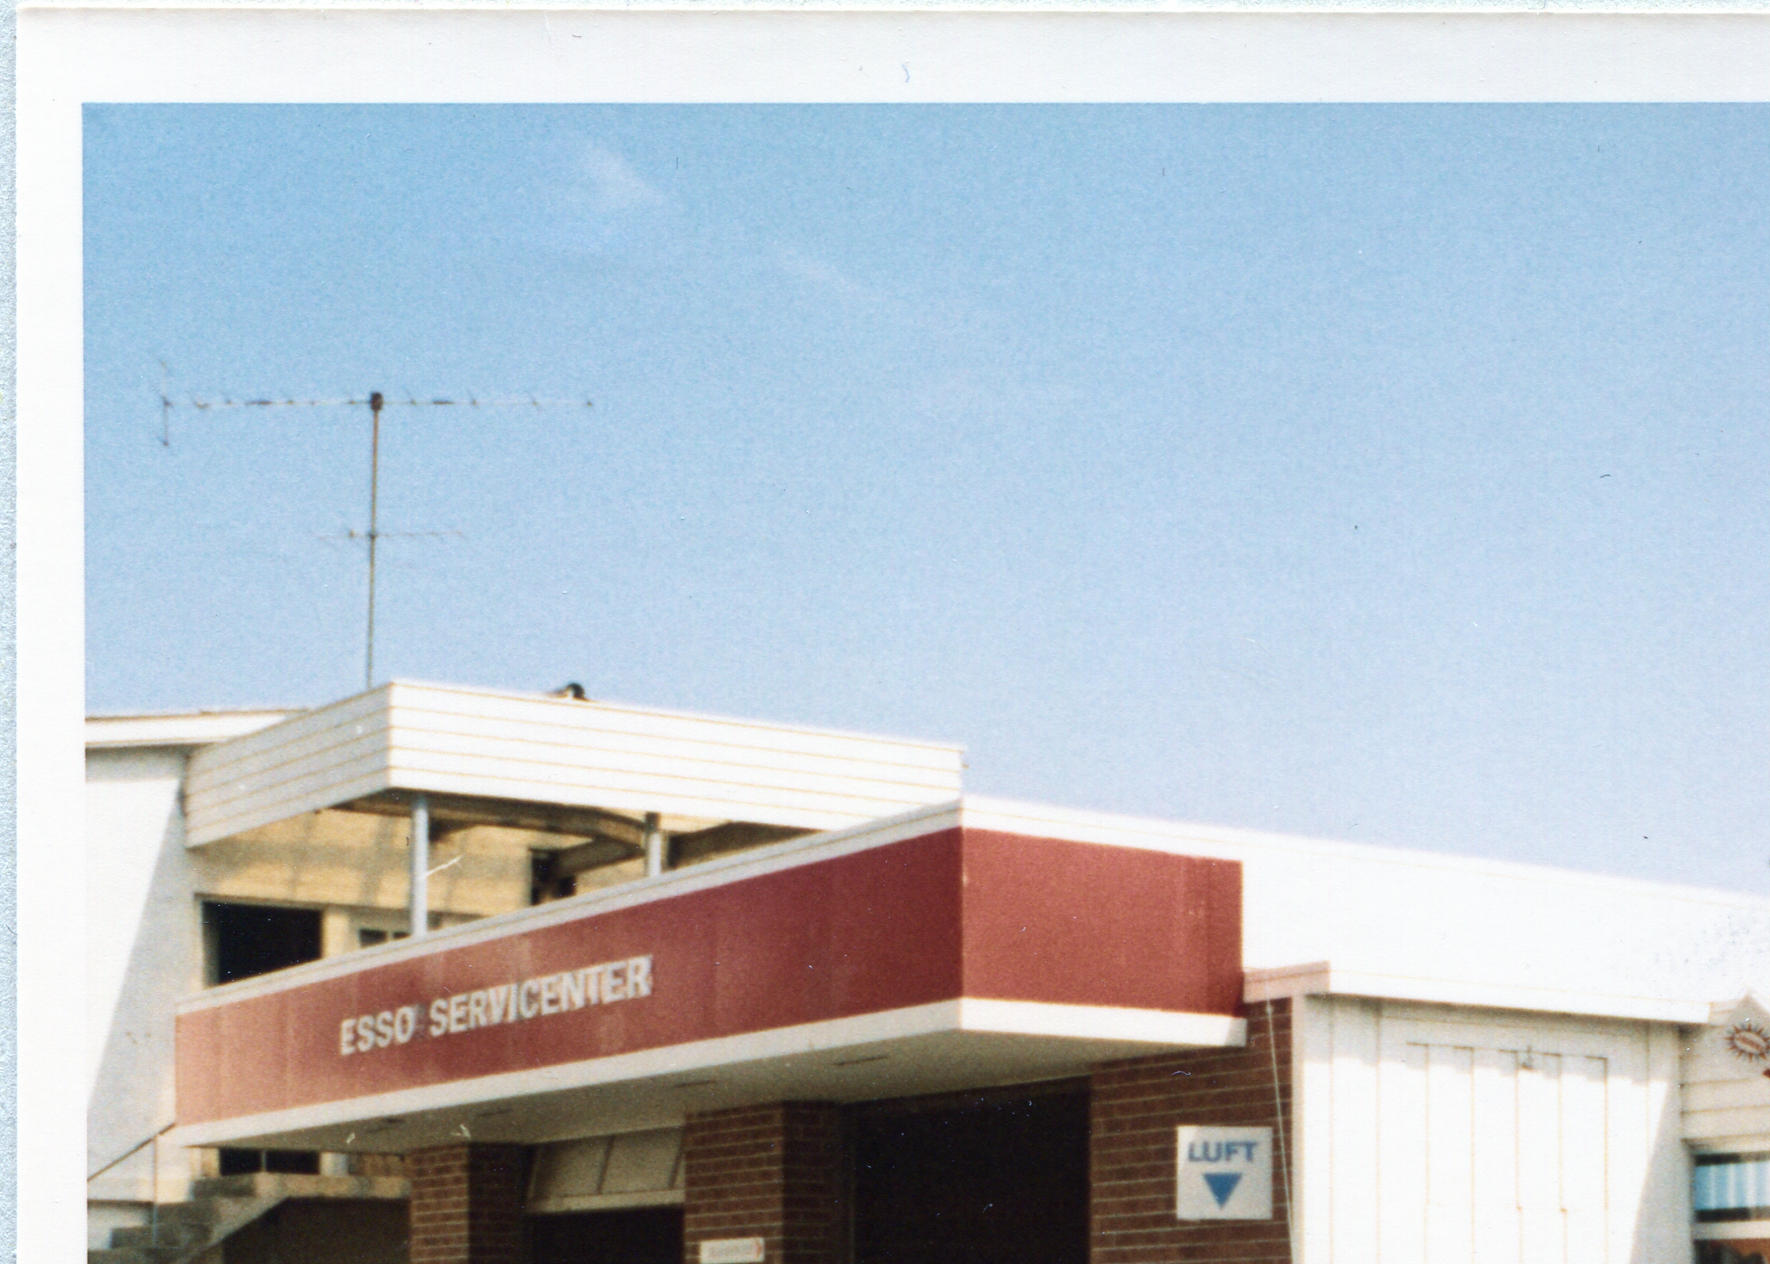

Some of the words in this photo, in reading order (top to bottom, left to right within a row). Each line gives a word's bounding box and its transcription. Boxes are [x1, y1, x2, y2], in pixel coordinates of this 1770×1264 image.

[340, 1005, 416, 1055] ESSO
[428, 954, 653, 1037] SERVICENTER
[1187, 1141, 1257, 1162] LUFT
